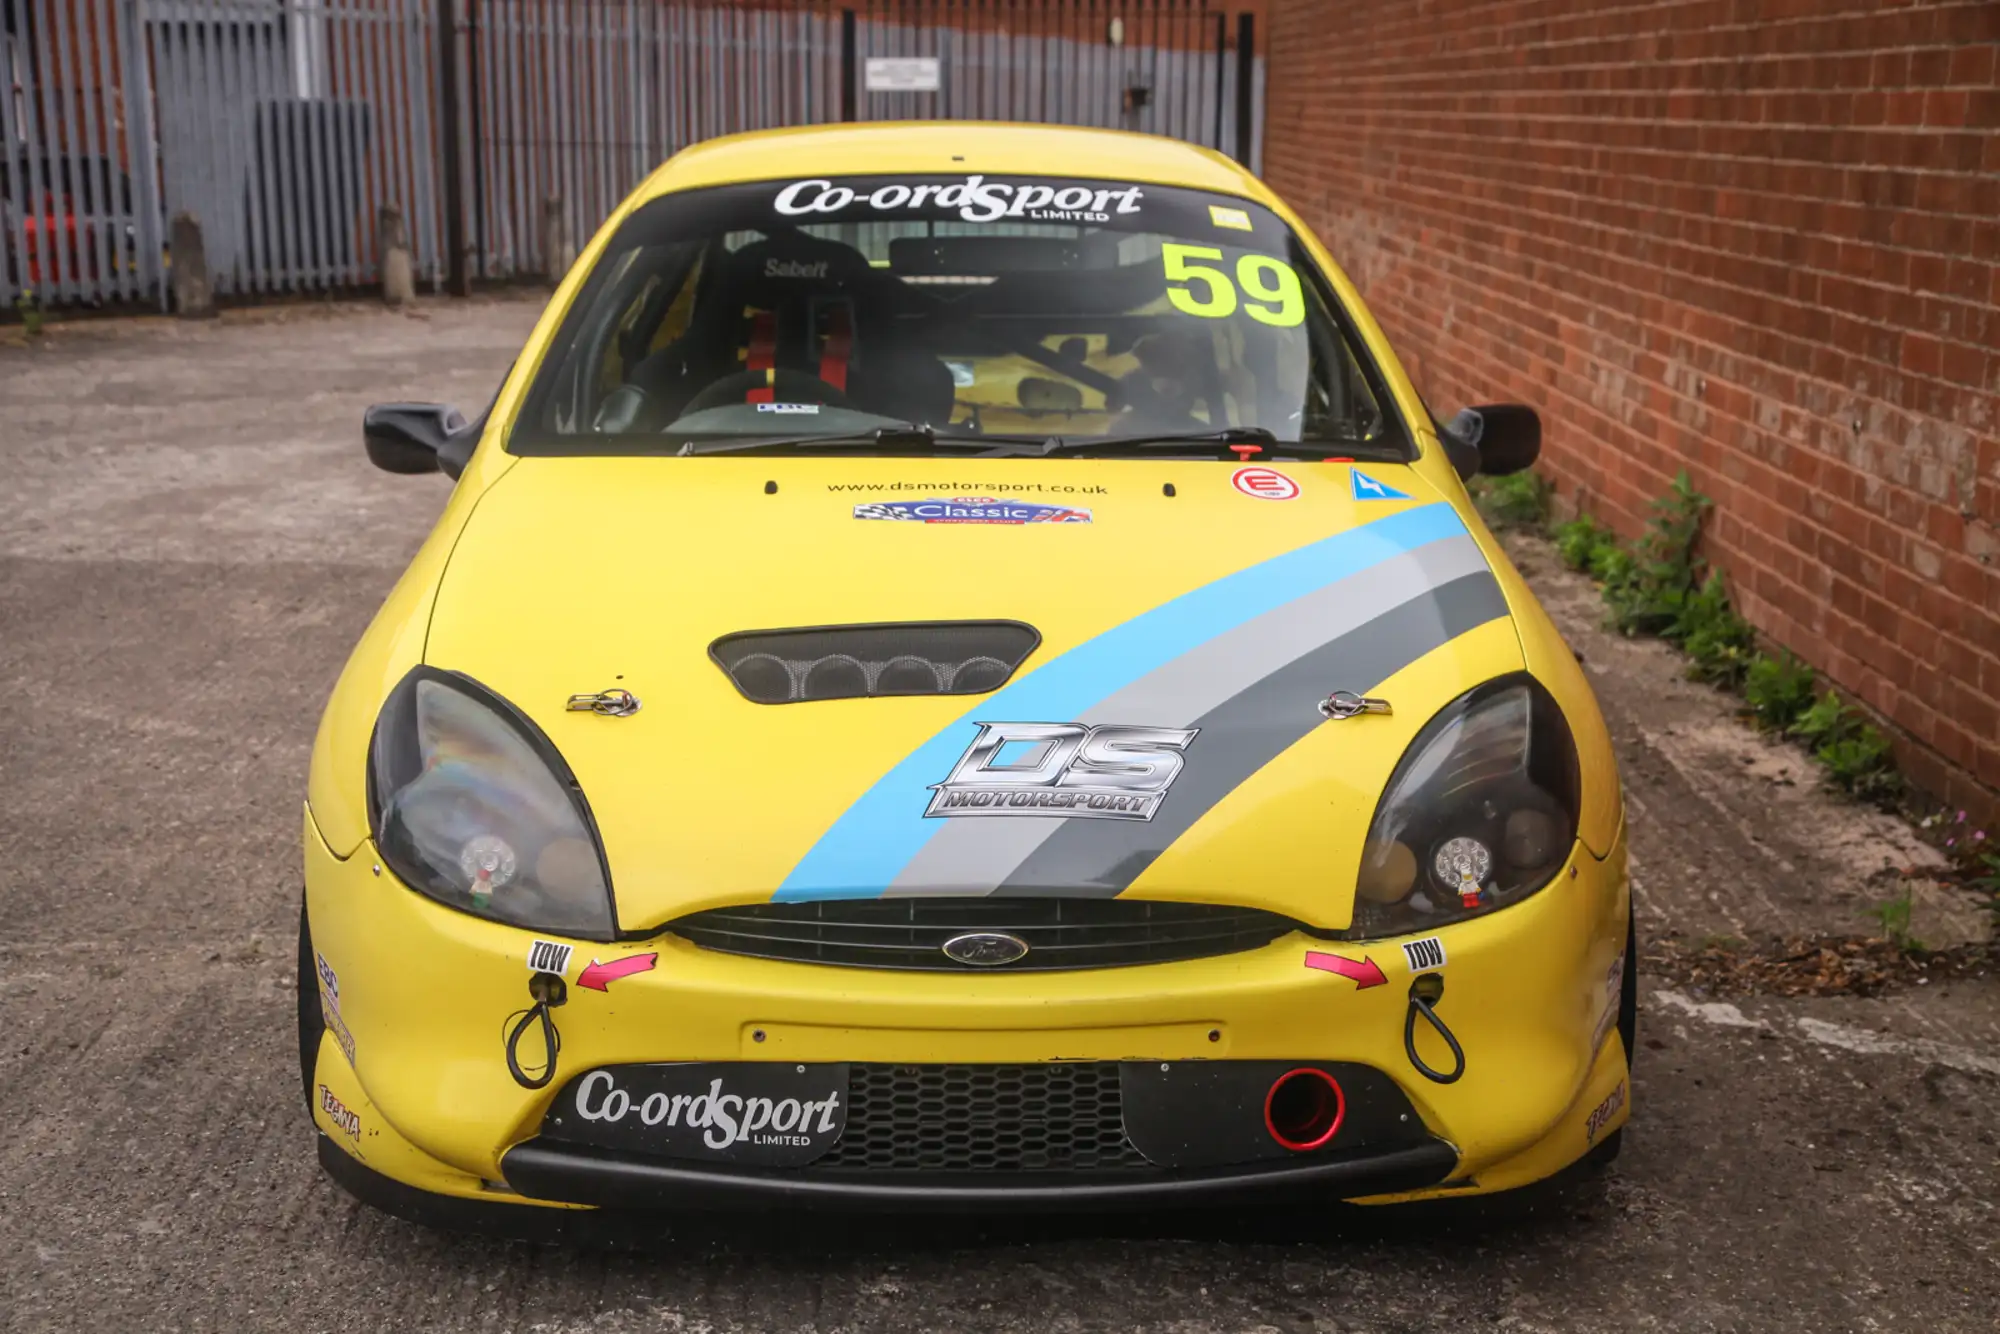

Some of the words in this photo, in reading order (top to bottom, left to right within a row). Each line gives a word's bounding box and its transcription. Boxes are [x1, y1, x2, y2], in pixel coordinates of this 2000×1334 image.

[1031, 209, 1110, 222] LIMITED
[1162, 243, 1306, 327] 59
[827, 481, 1108, 495] www.dsmotorsport.co.uk
[913, 504, 1029, 519] Classic
[972, 720, 1202, 793] DS
[943, 790, 1152, 813] MOTORSPORT
[530, 940, 571, 973] TOW
[1403, 938, 1443, 970] TOW
[754, 1134, 811, 1147] LIMITED
